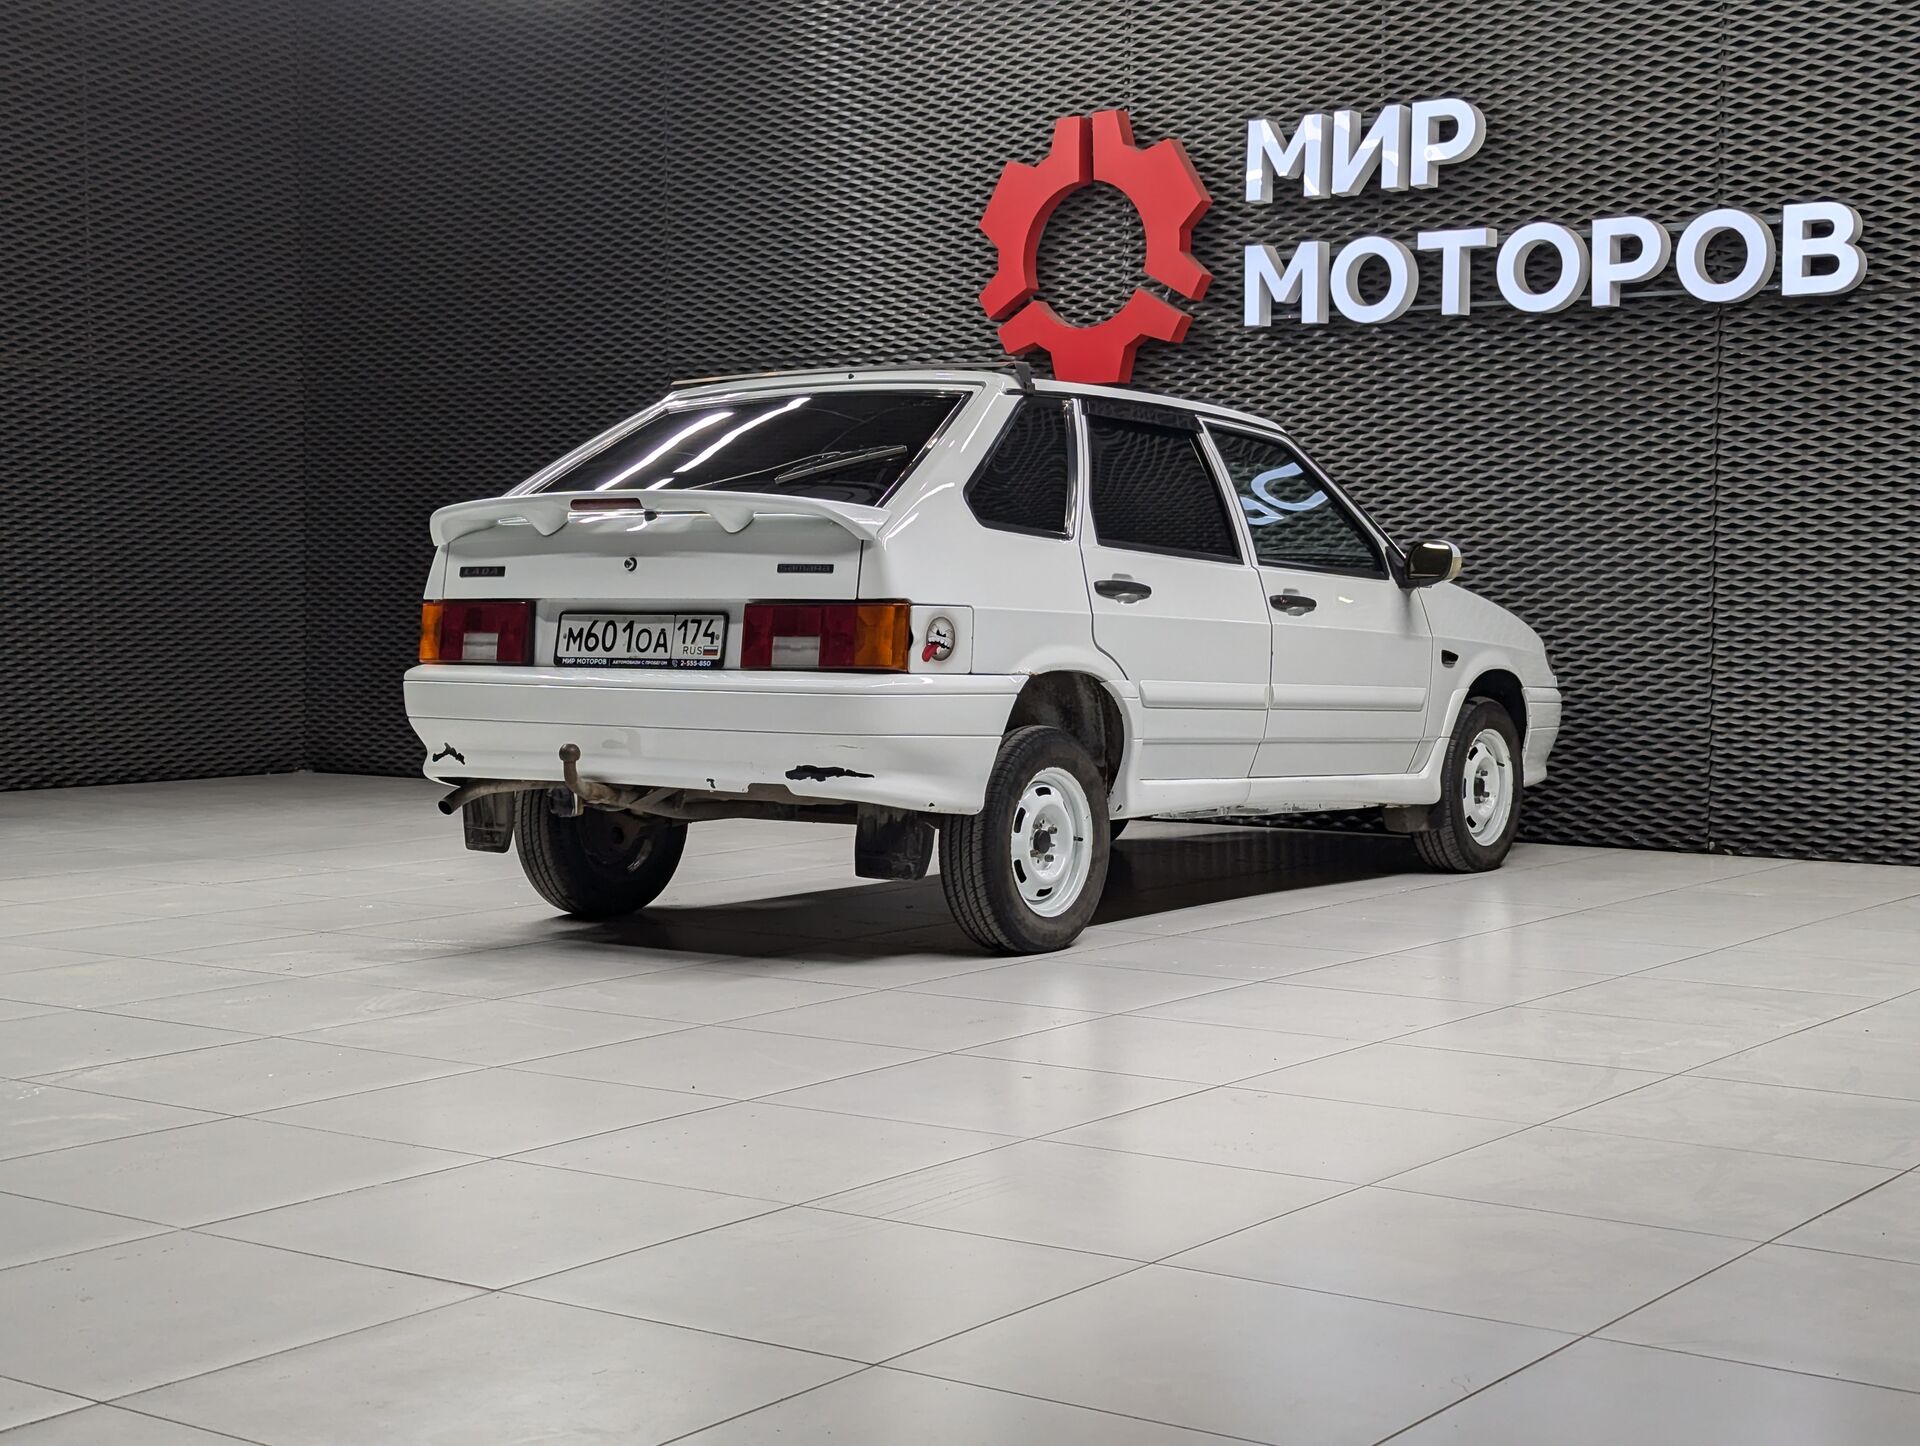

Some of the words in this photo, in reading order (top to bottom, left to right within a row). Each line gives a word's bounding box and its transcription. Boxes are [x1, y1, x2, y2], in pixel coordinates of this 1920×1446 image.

[1245, 97, 1487, 205] МИР
[1243, 201, 1868, 328] МОТОРОВ
[677, 618, 716, 645] 174
[561, 657, 576, 665] МИР
[682, 645, 703, 655] RUS
